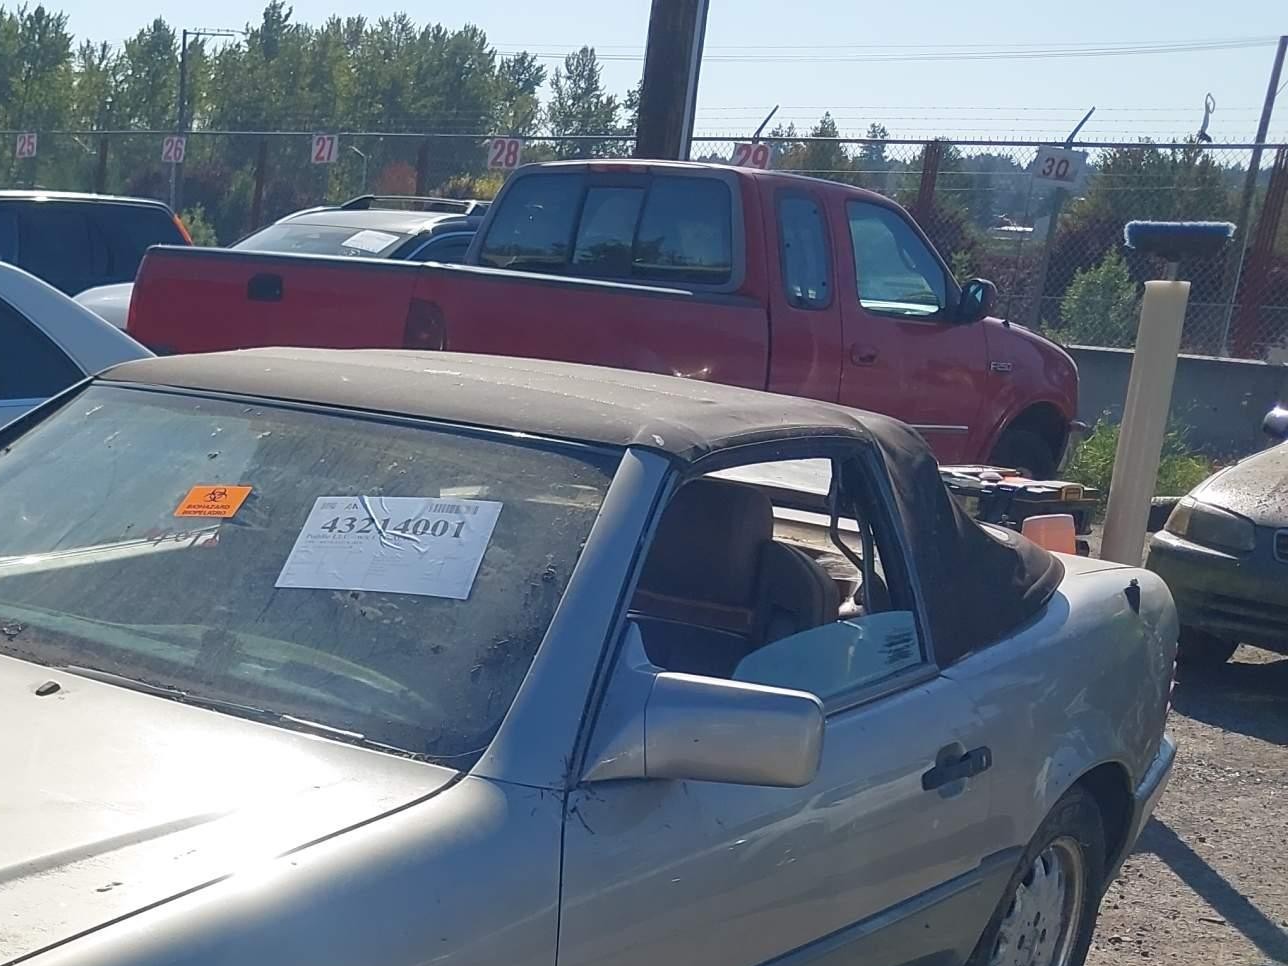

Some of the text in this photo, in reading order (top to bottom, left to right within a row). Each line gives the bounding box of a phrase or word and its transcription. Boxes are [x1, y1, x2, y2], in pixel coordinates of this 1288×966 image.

[18, 135, 36, 156] 25
[164, 138, 184, 161] 26
[315, 137, 334, 161] 27
[491, 140, 520, 167] 28
[736, 144, 769, 169] 29
[1042, 157, 1069, 178] 30
[320, 515, 466, 539] 43214001
